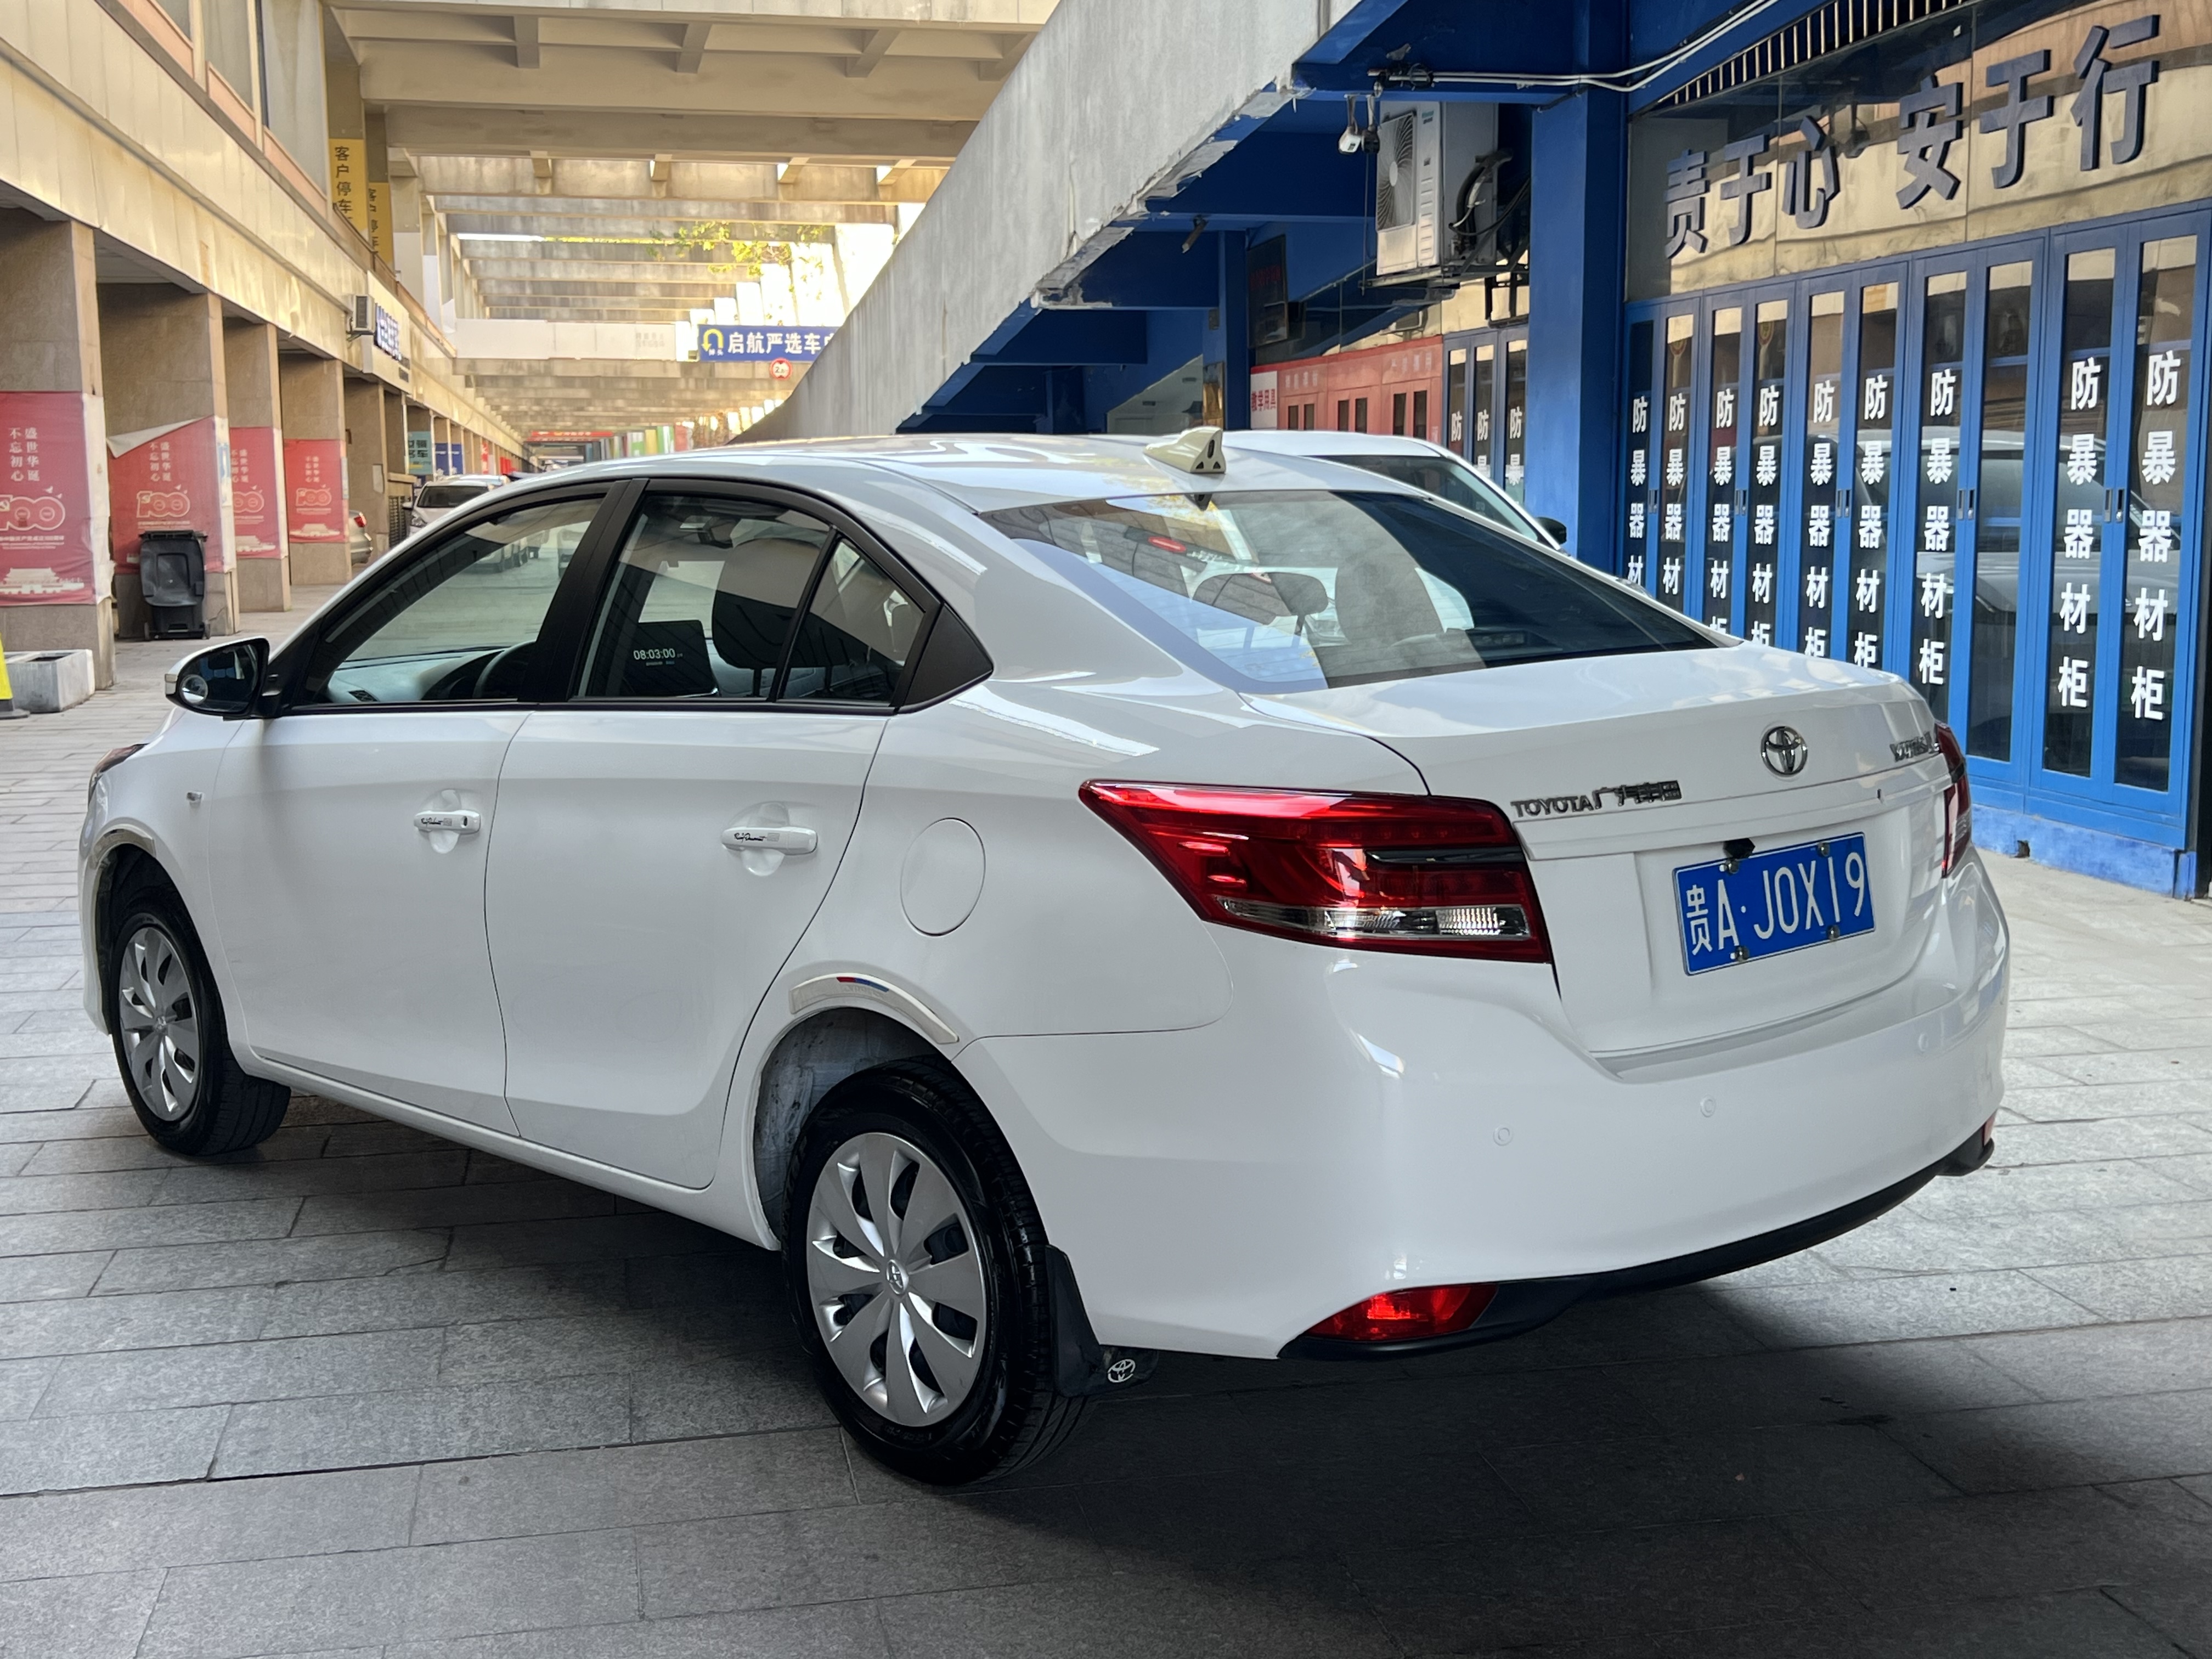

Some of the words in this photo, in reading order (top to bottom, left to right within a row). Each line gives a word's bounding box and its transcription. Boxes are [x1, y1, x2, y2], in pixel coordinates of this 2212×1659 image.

[335, 146, 352, 219] 客户停车
[1664, 116, 1839, 258] 责于心
[1897, 14, 2160, 209] 安于行
[1509, 406, 1522, 505] 防暴
[1663, 393, 1686, 595] 防暴器材
[1805, 380, 1834, 658] 防暴器材柜
[1854, 374, 1887, 668] 防暴器材柜
[1918, 369, 1956, 685] 防暴器材柜
[2058, 357, 2101, 708] 防暴器材柜
[2131, 350, 2180, 720] 防暴器材柜
[634, 648, 675, 660] 08:03:00
[1510, 795, 1594, 817] TOYOTA
